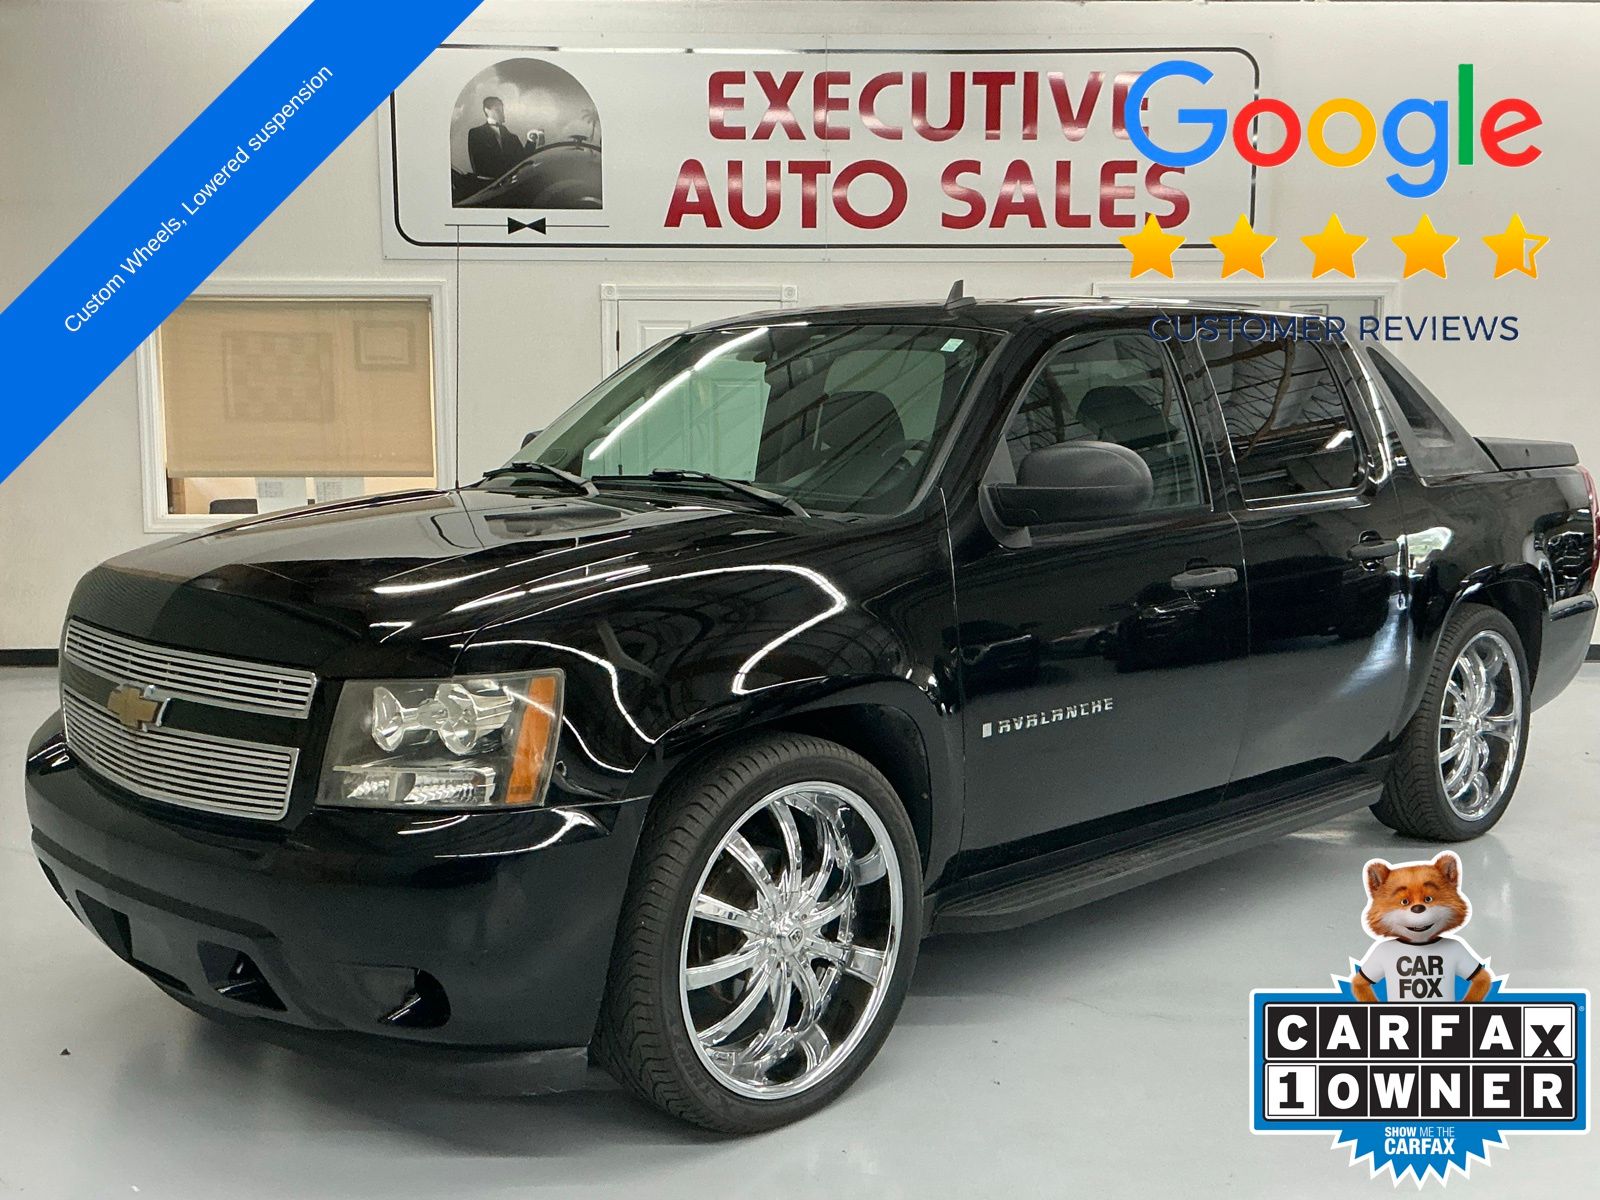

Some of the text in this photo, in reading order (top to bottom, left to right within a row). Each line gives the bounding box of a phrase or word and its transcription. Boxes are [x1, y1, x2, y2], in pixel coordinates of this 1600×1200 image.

[663, 158, 1191, 230] AUTO SALES
[997, 697, 1114, 735] AVALANCHE
